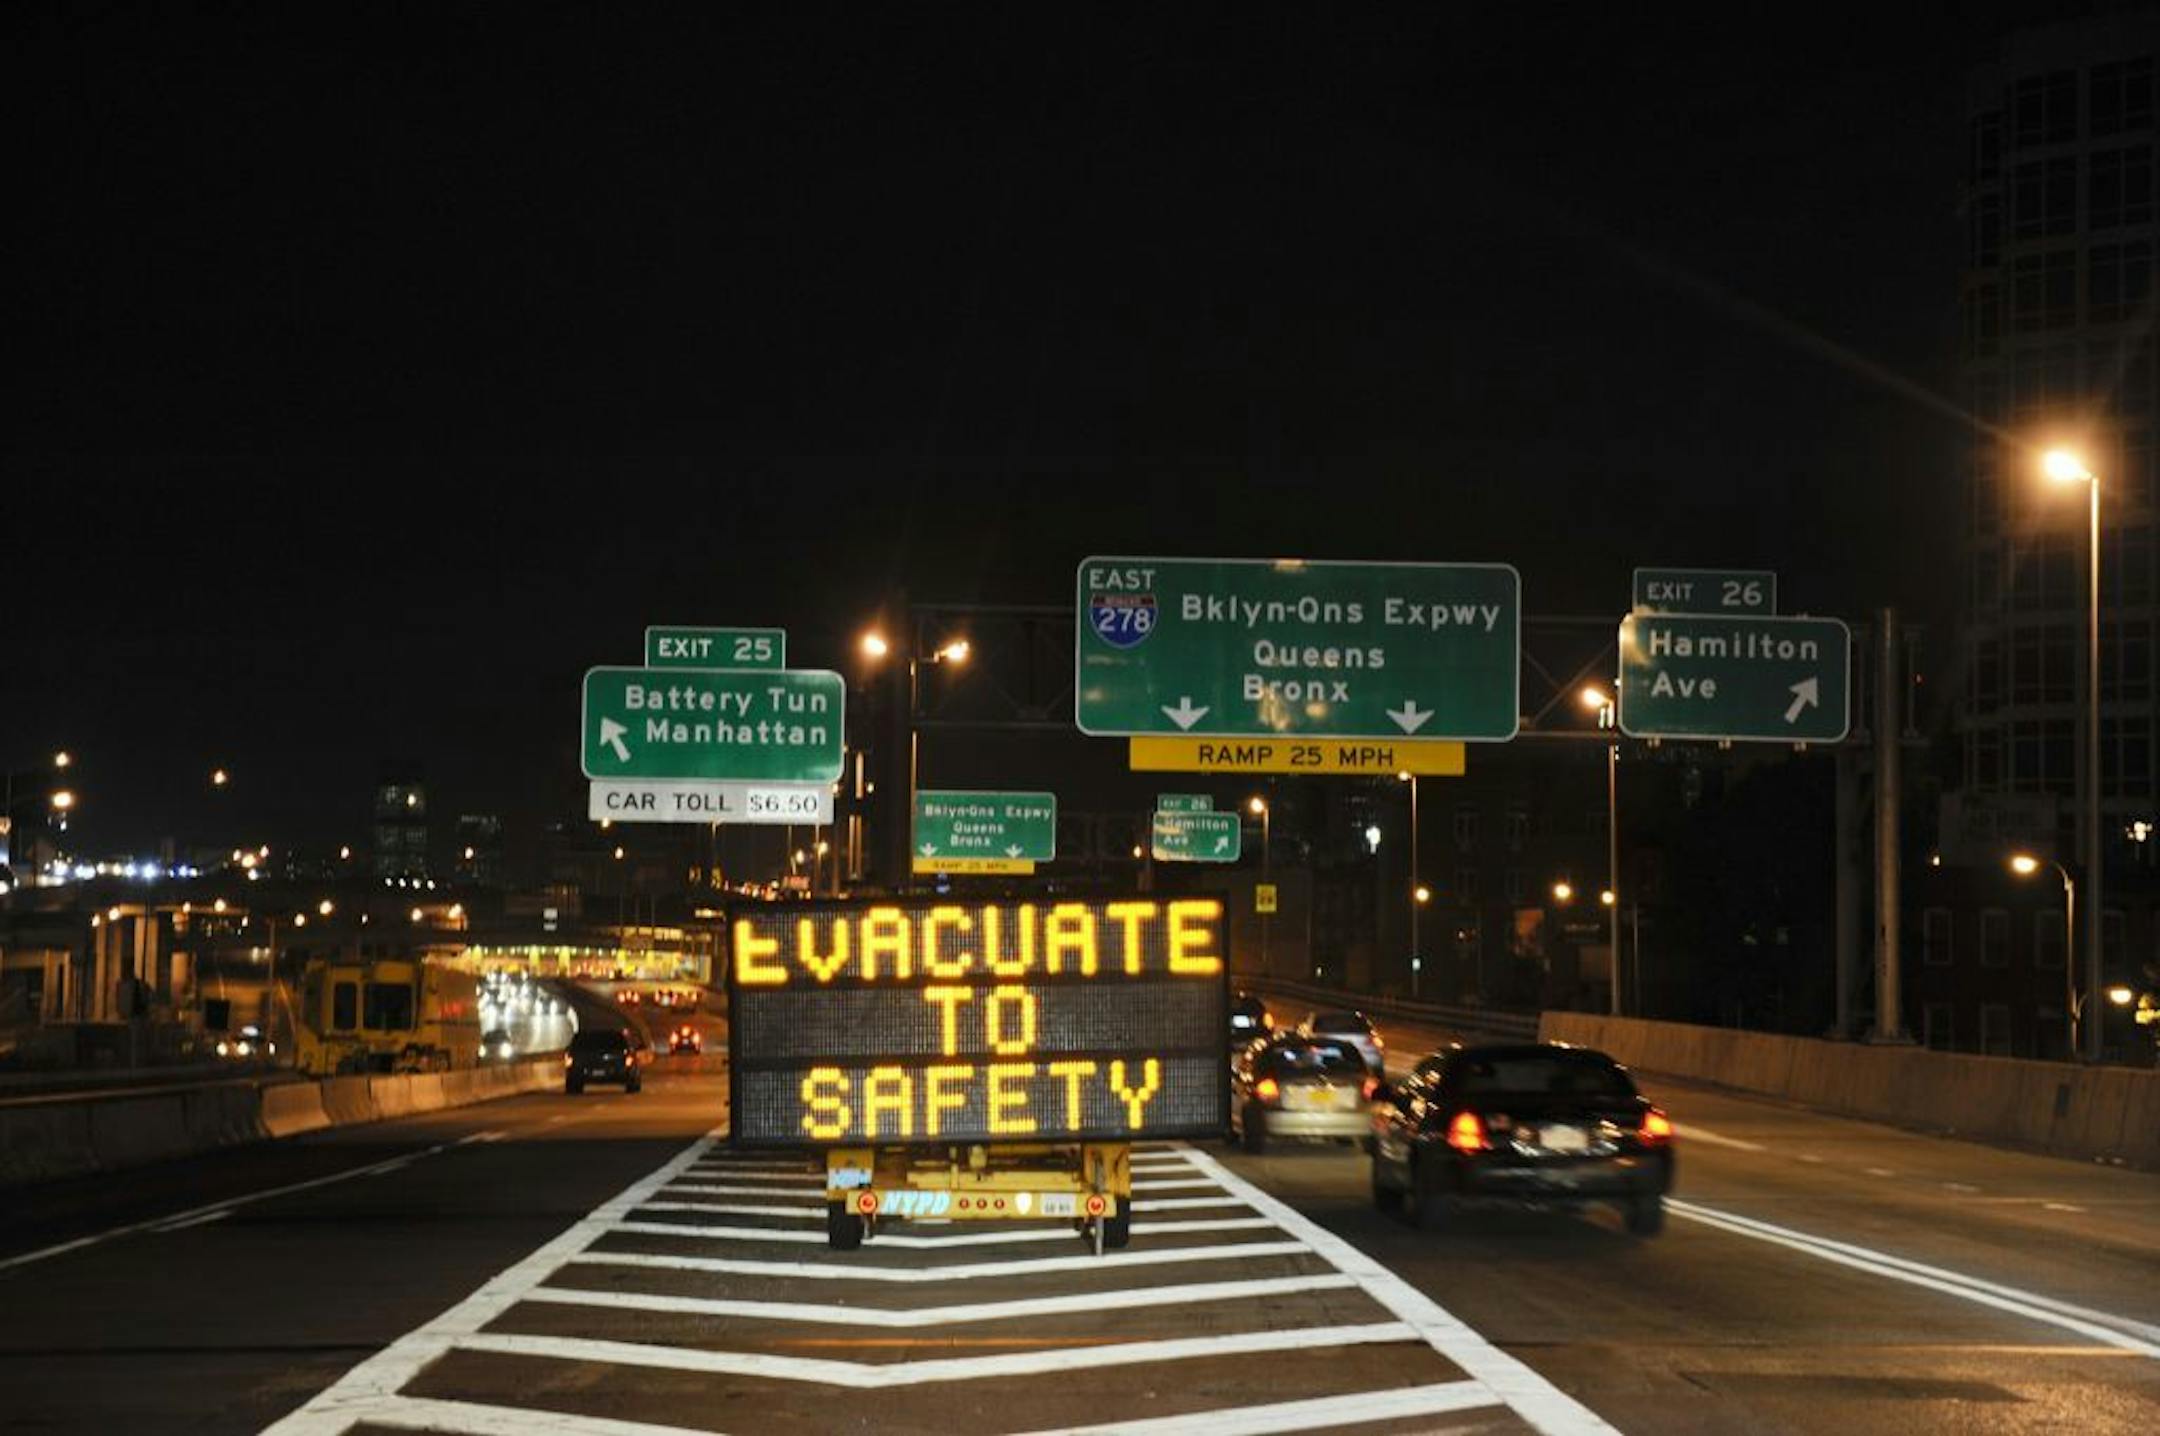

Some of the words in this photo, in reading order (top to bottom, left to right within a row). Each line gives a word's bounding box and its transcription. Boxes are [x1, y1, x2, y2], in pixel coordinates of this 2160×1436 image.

[1090, 569, 1156, 590] EAST
[1648, 582, 1693, 600] EXIT
[1722, 580, 1763, 606] 26
[1099, 607, 1151, 633] 278
[1182, 595, 1364, 628] Bklyn-Qns
[1385, 599, 1500, 631] Expwy
[658, 638, 713, 658] EXIT
[734, 638, 772, 661] 25
[1254, 640, 1385, 668] Queens
[1650, 629, 1818, 661] Hamilton
[1243, 674, 1350, 702] Bronx
[1651, 670, 1717, 699] Ave
[625, 685, 753, 717] Battery
[768, 688, 828, 713] Tun
[646, 718, 827, 746] Manhattan
[1199, 745, 1274, 766] RAMP
[1290, 747, 1323, 766] 25
[1339, 747, 1394, 767] MPH
[606, 792, 656, 811] CAR
[672, 793, 733, 812] TOLL
[749, 794, 818, 814] $6.50
[953, 820, 1005, 834] Queens
[734, 900, 1223, 984] EVACUATE
[924, 985, 1038, 1056] TO
[802, 1058, 1160, 1139] SAFETY
[881, 1190, 950, 1215] NYPD
